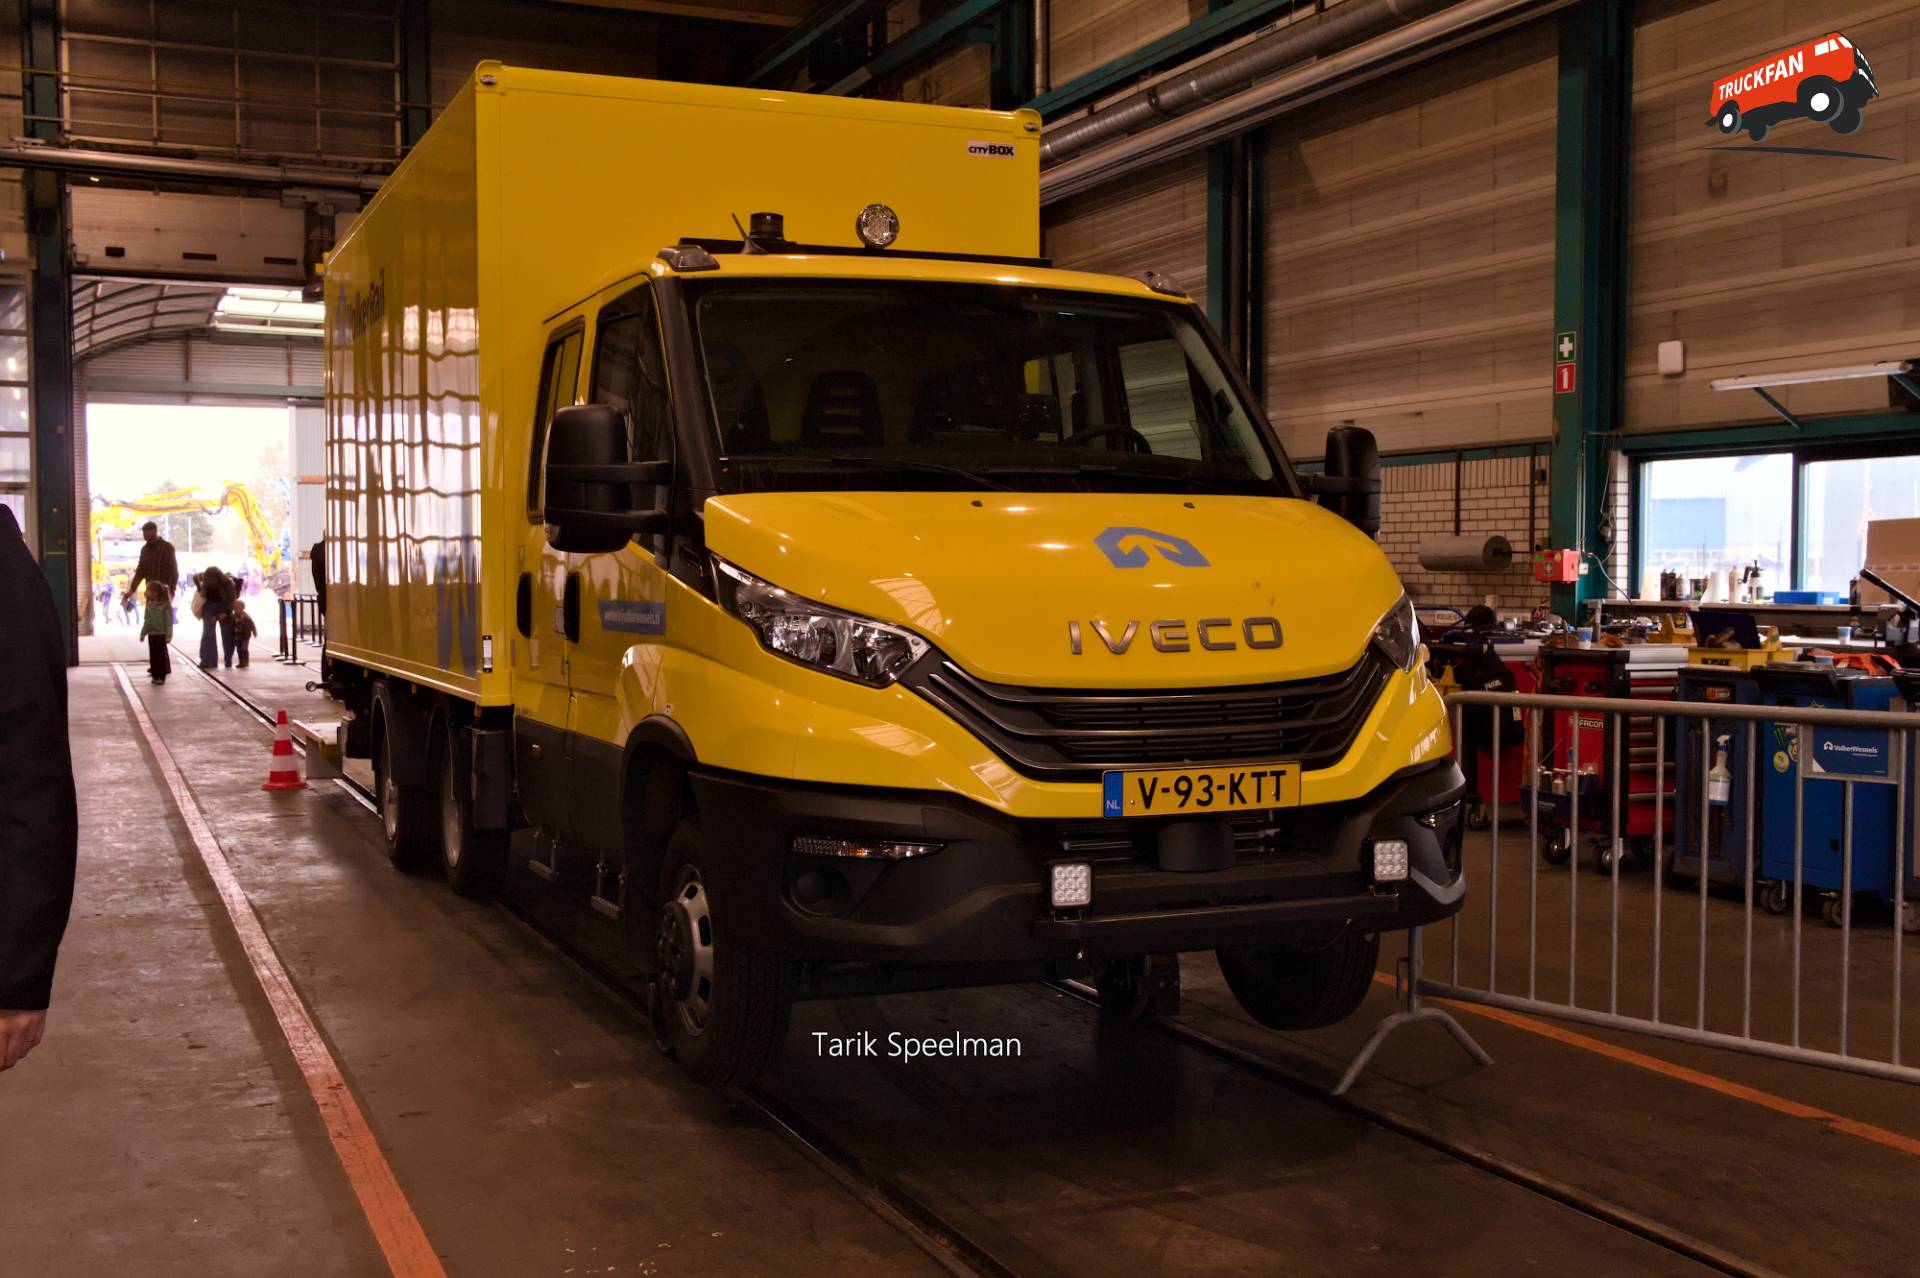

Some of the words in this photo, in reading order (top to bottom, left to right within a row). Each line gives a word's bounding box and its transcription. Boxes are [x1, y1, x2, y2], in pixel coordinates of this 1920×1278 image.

[1561, 367, 1569, 389] 1
[1069, 617, 1283, 655] IVECO
[1106, 799, 1121, 810] NL
[1138, 770, 1287, 809] V-93-KTT
